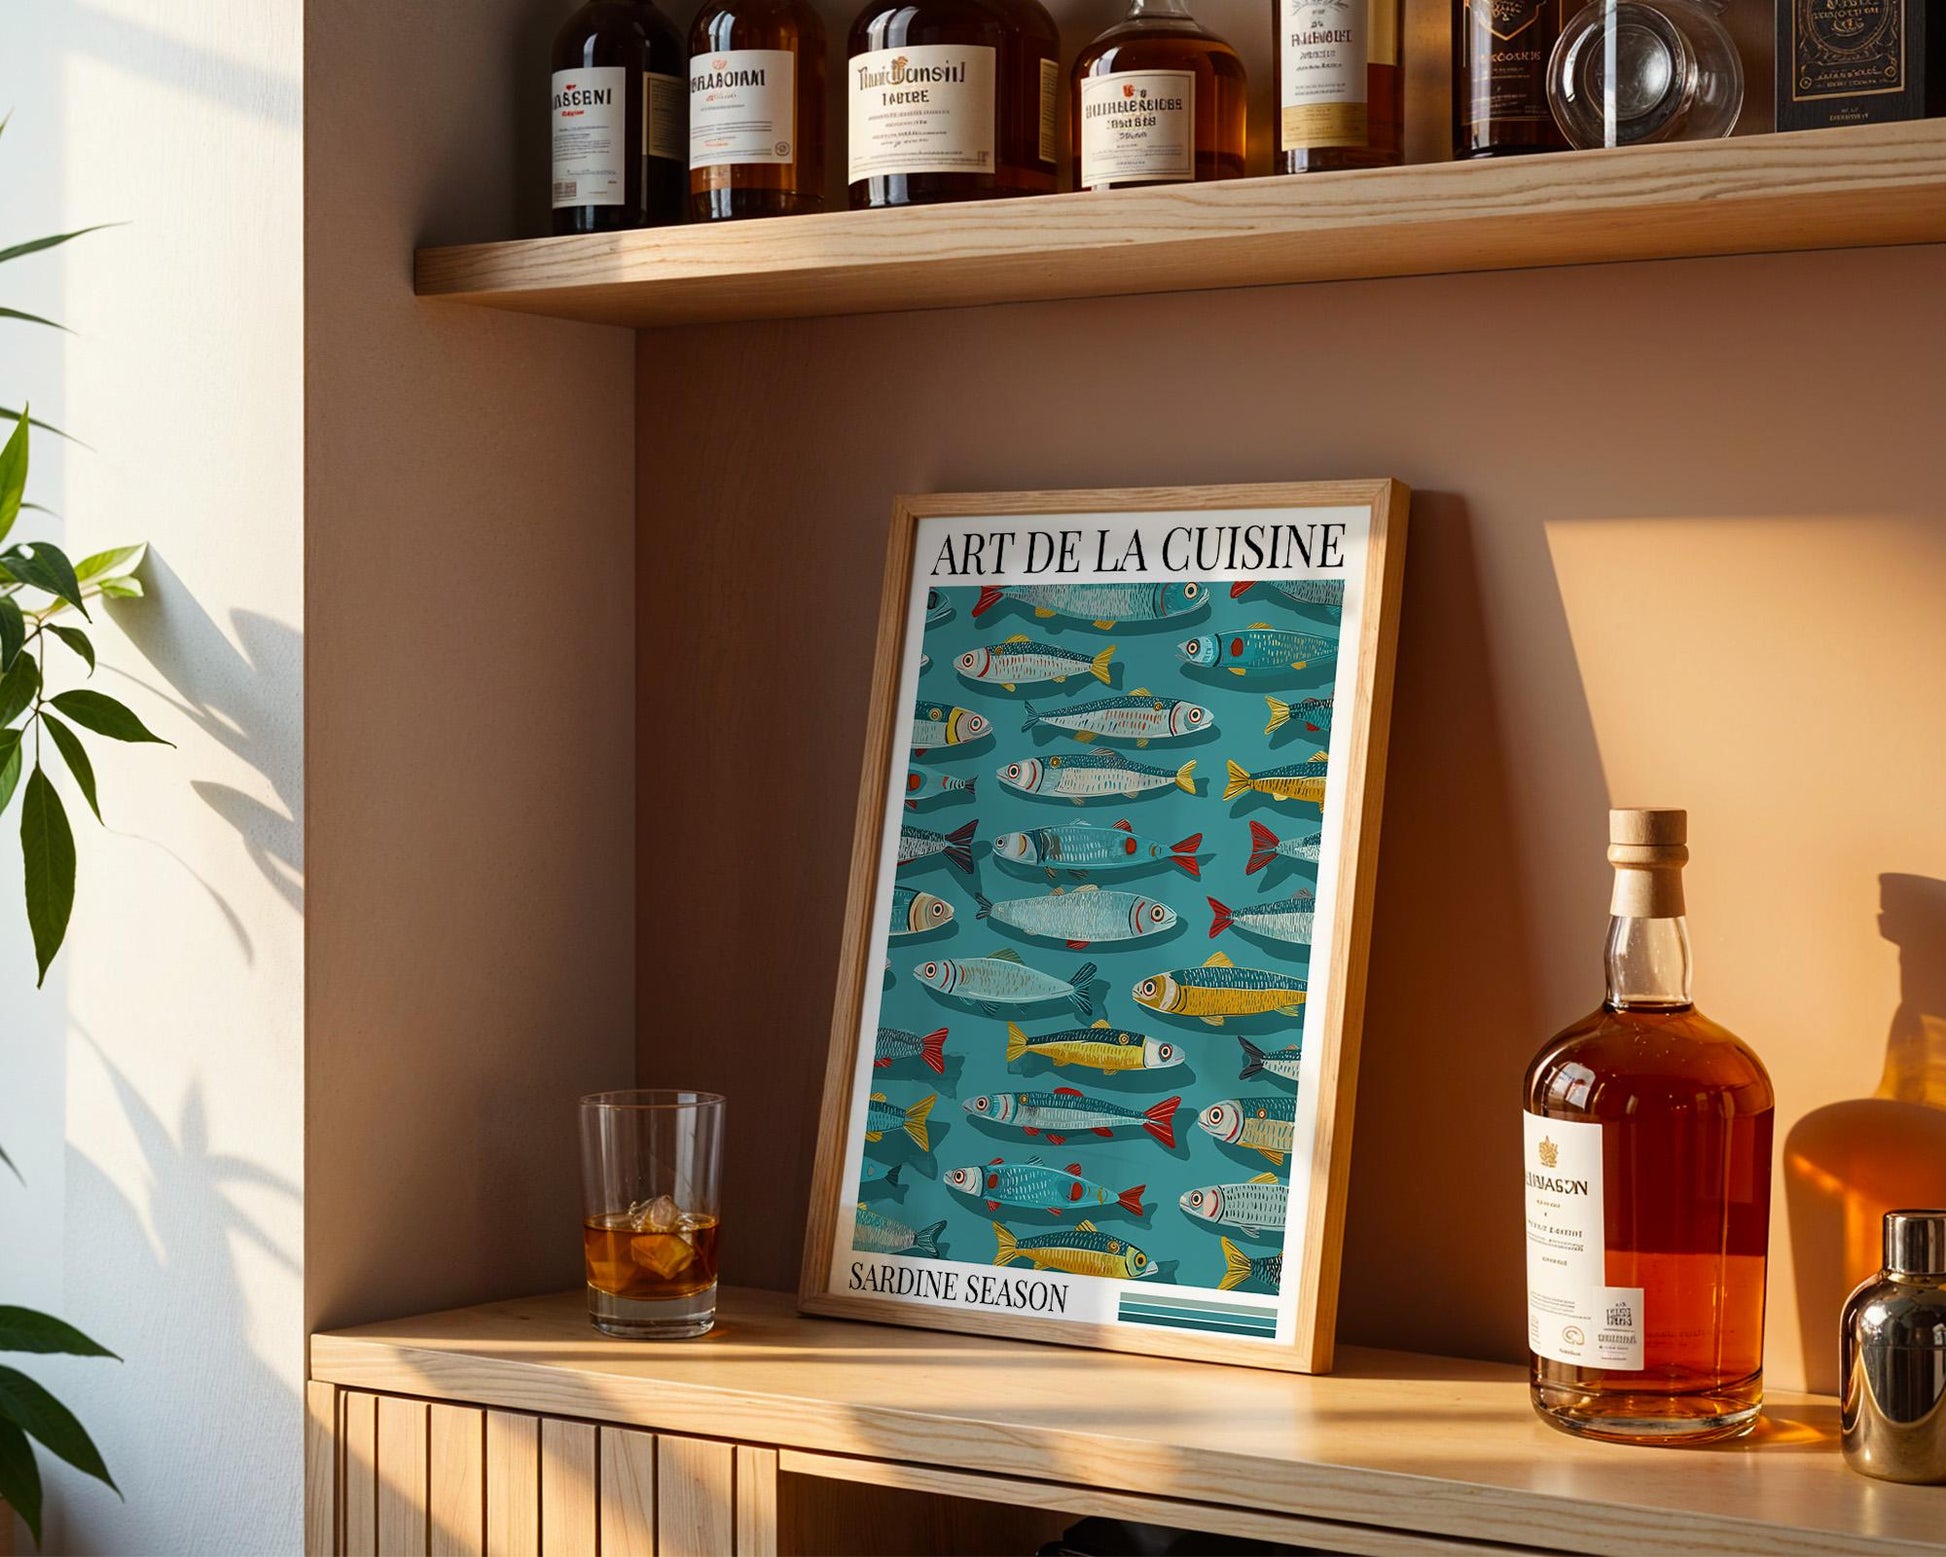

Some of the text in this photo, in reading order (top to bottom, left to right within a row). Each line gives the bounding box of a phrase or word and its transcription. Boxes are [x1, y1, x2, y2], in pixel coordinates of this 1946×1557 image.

[930, 523, 1347, 576] ART DE LA CUISINE
[849, 1261, 1069, 1314] SARDINE SEASON
